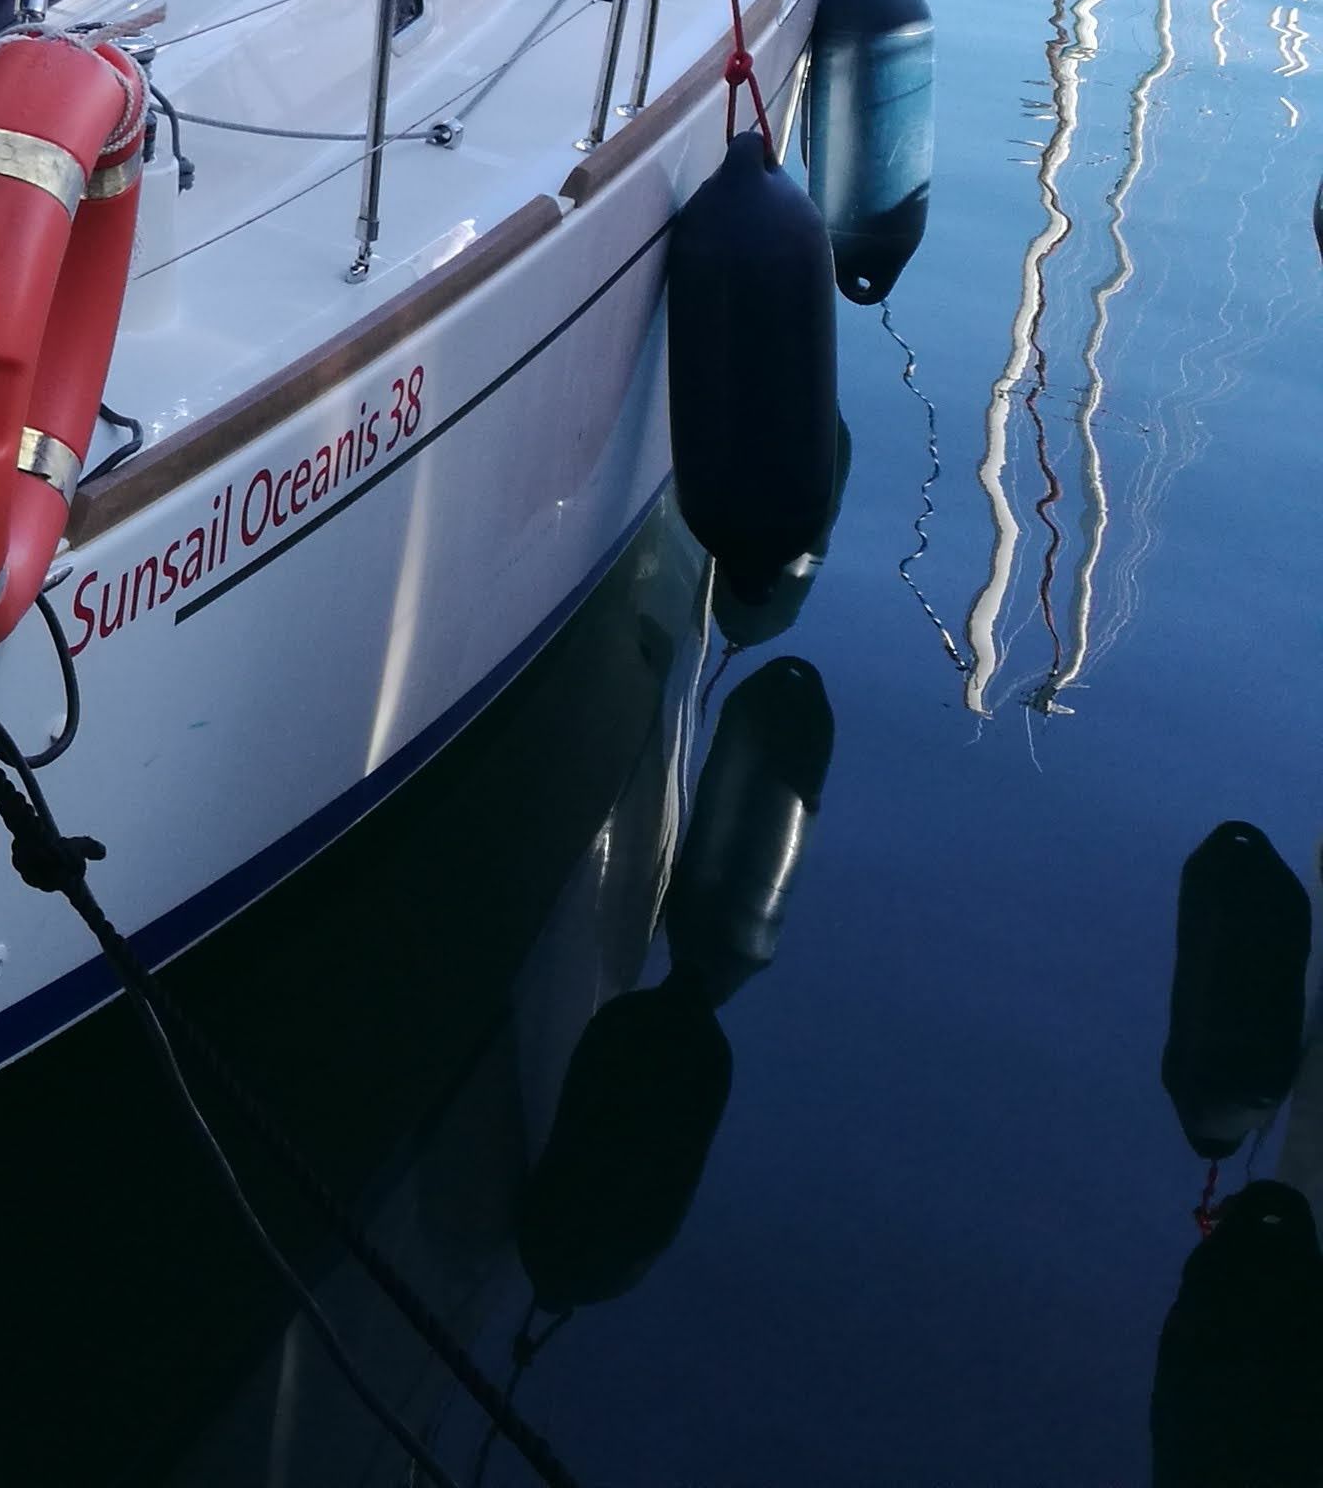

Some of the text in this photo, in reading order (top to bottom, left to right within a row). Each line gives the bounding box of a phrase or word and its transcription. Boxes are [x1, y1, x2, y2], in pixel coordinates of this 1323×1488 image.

[68, 364, 425, 658] Sunsail Oceanis 38
